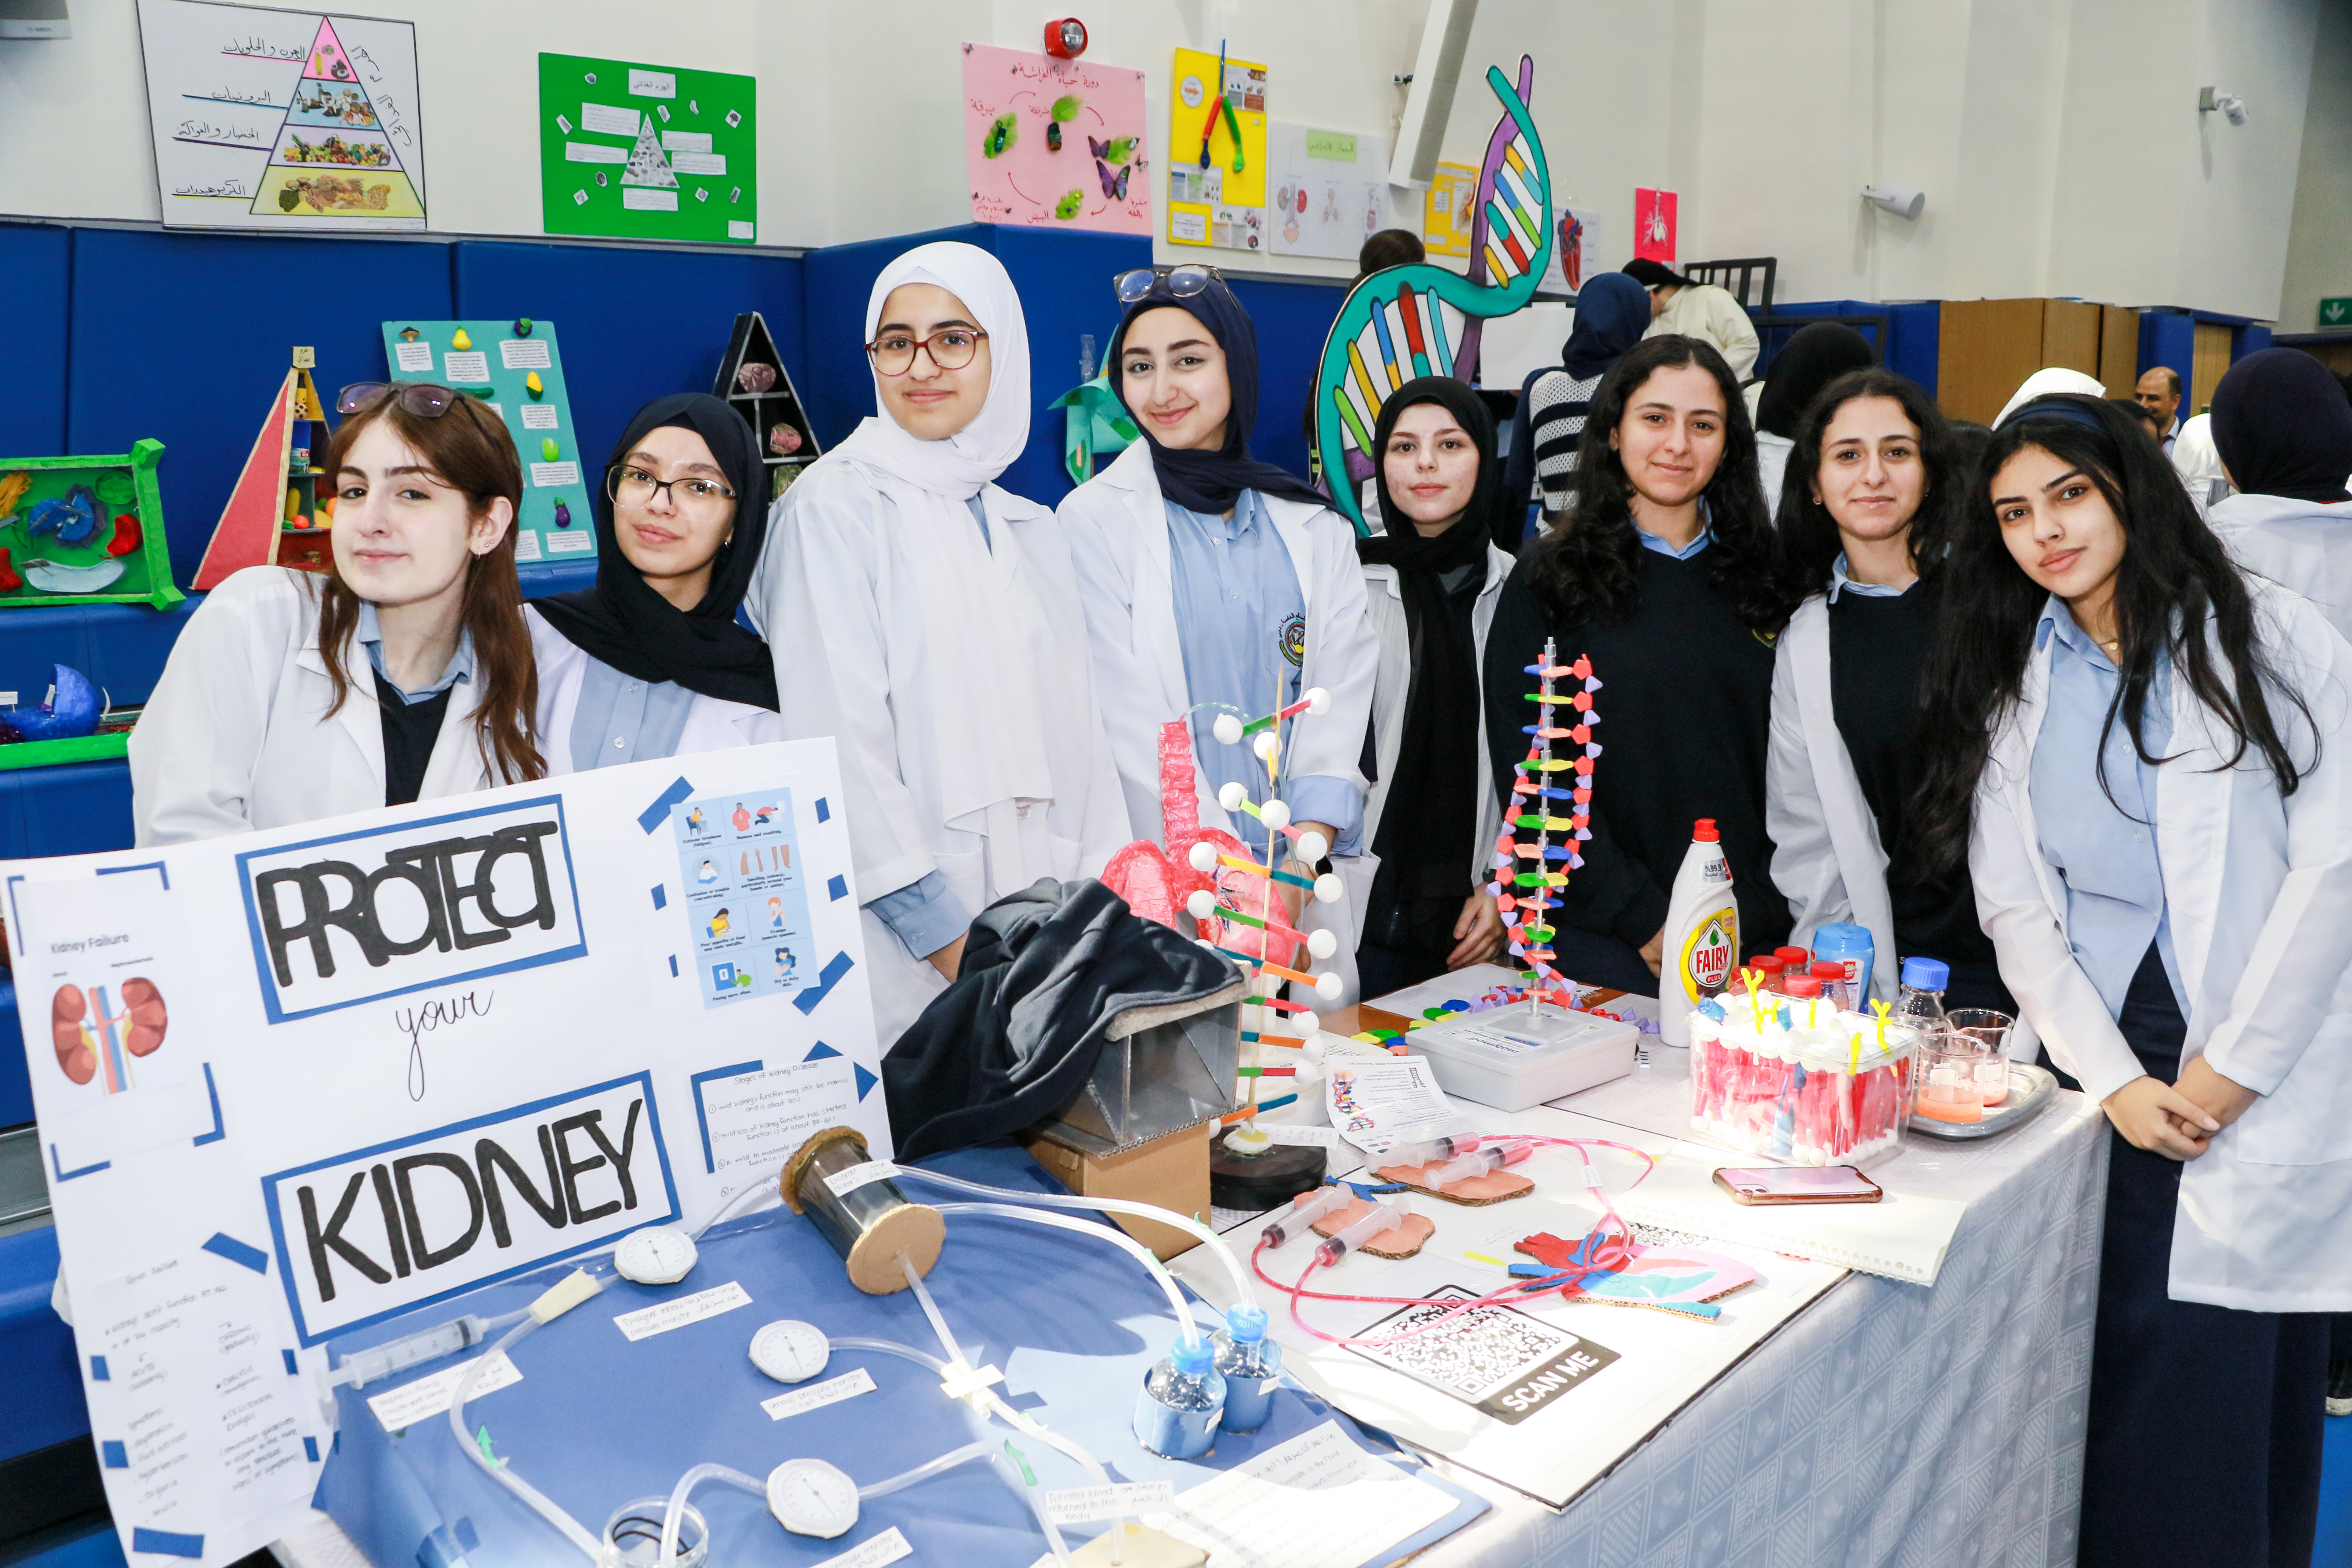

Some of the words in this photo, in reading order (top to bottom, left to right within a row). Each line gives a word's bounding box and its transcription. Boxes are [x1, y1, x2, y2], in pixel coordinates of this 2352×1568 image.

[256, 821, 558, 988] PROTECT
[51, 940, 86, 956] Kidney
[89, 935, 129, 947] Failure
[1696, 944, 1730, 974] FAIRY
[1708, 974, 1721, 983] PLUS
[395, 989, 494, 1102] your
[1468, 1036, 1519, 1054] molymod
[735, 1075, 756, 1084] Stages
[793, 1062, 818, 1071] Disease
[297, 1098, 643, 1302] KIDNEY
[1501, 1371, 1568, 1412] SCAN
[1555, 1351, 1599, 1377] ME
[1089, 1487, 1112, 1497] blood
[1066, 1513, 1090, 1524] body
